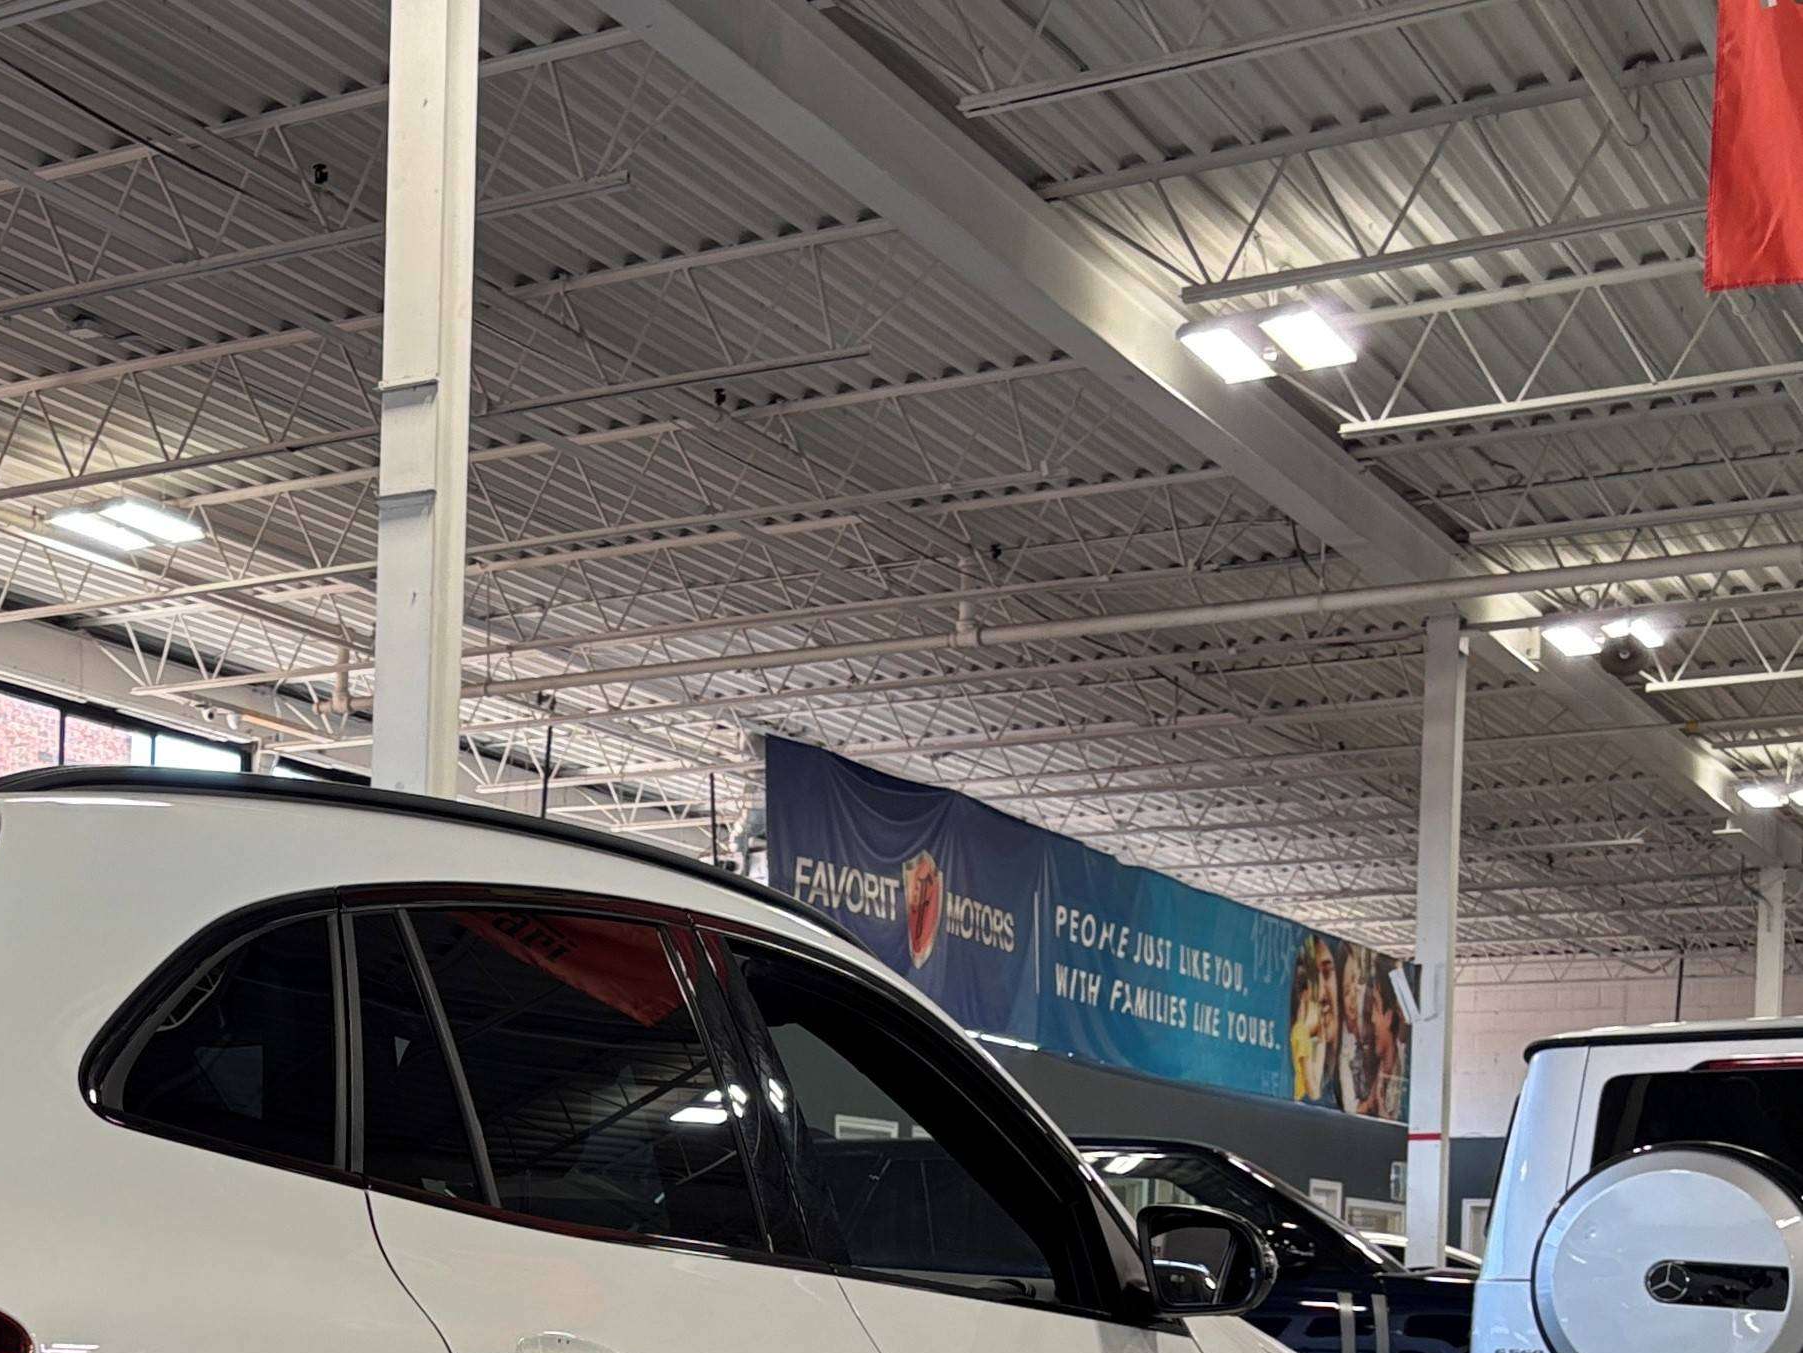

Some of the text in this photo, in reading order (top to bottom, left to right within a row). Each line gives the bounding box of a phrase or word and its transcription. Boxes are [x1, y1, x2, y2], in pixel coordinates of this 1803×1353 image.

[794, 856, 899, 921] FAVORIT
[946, 892, 1015, 952] MOTORS
[1055, 962, 1282, 1051] WITH FAMILIES LIKE YOURS.
[1133, 931, 1172, 970] JUST
[1179, 944, 1211, 982] LIKE
[1214, 954, 1249, 996] YOU,
